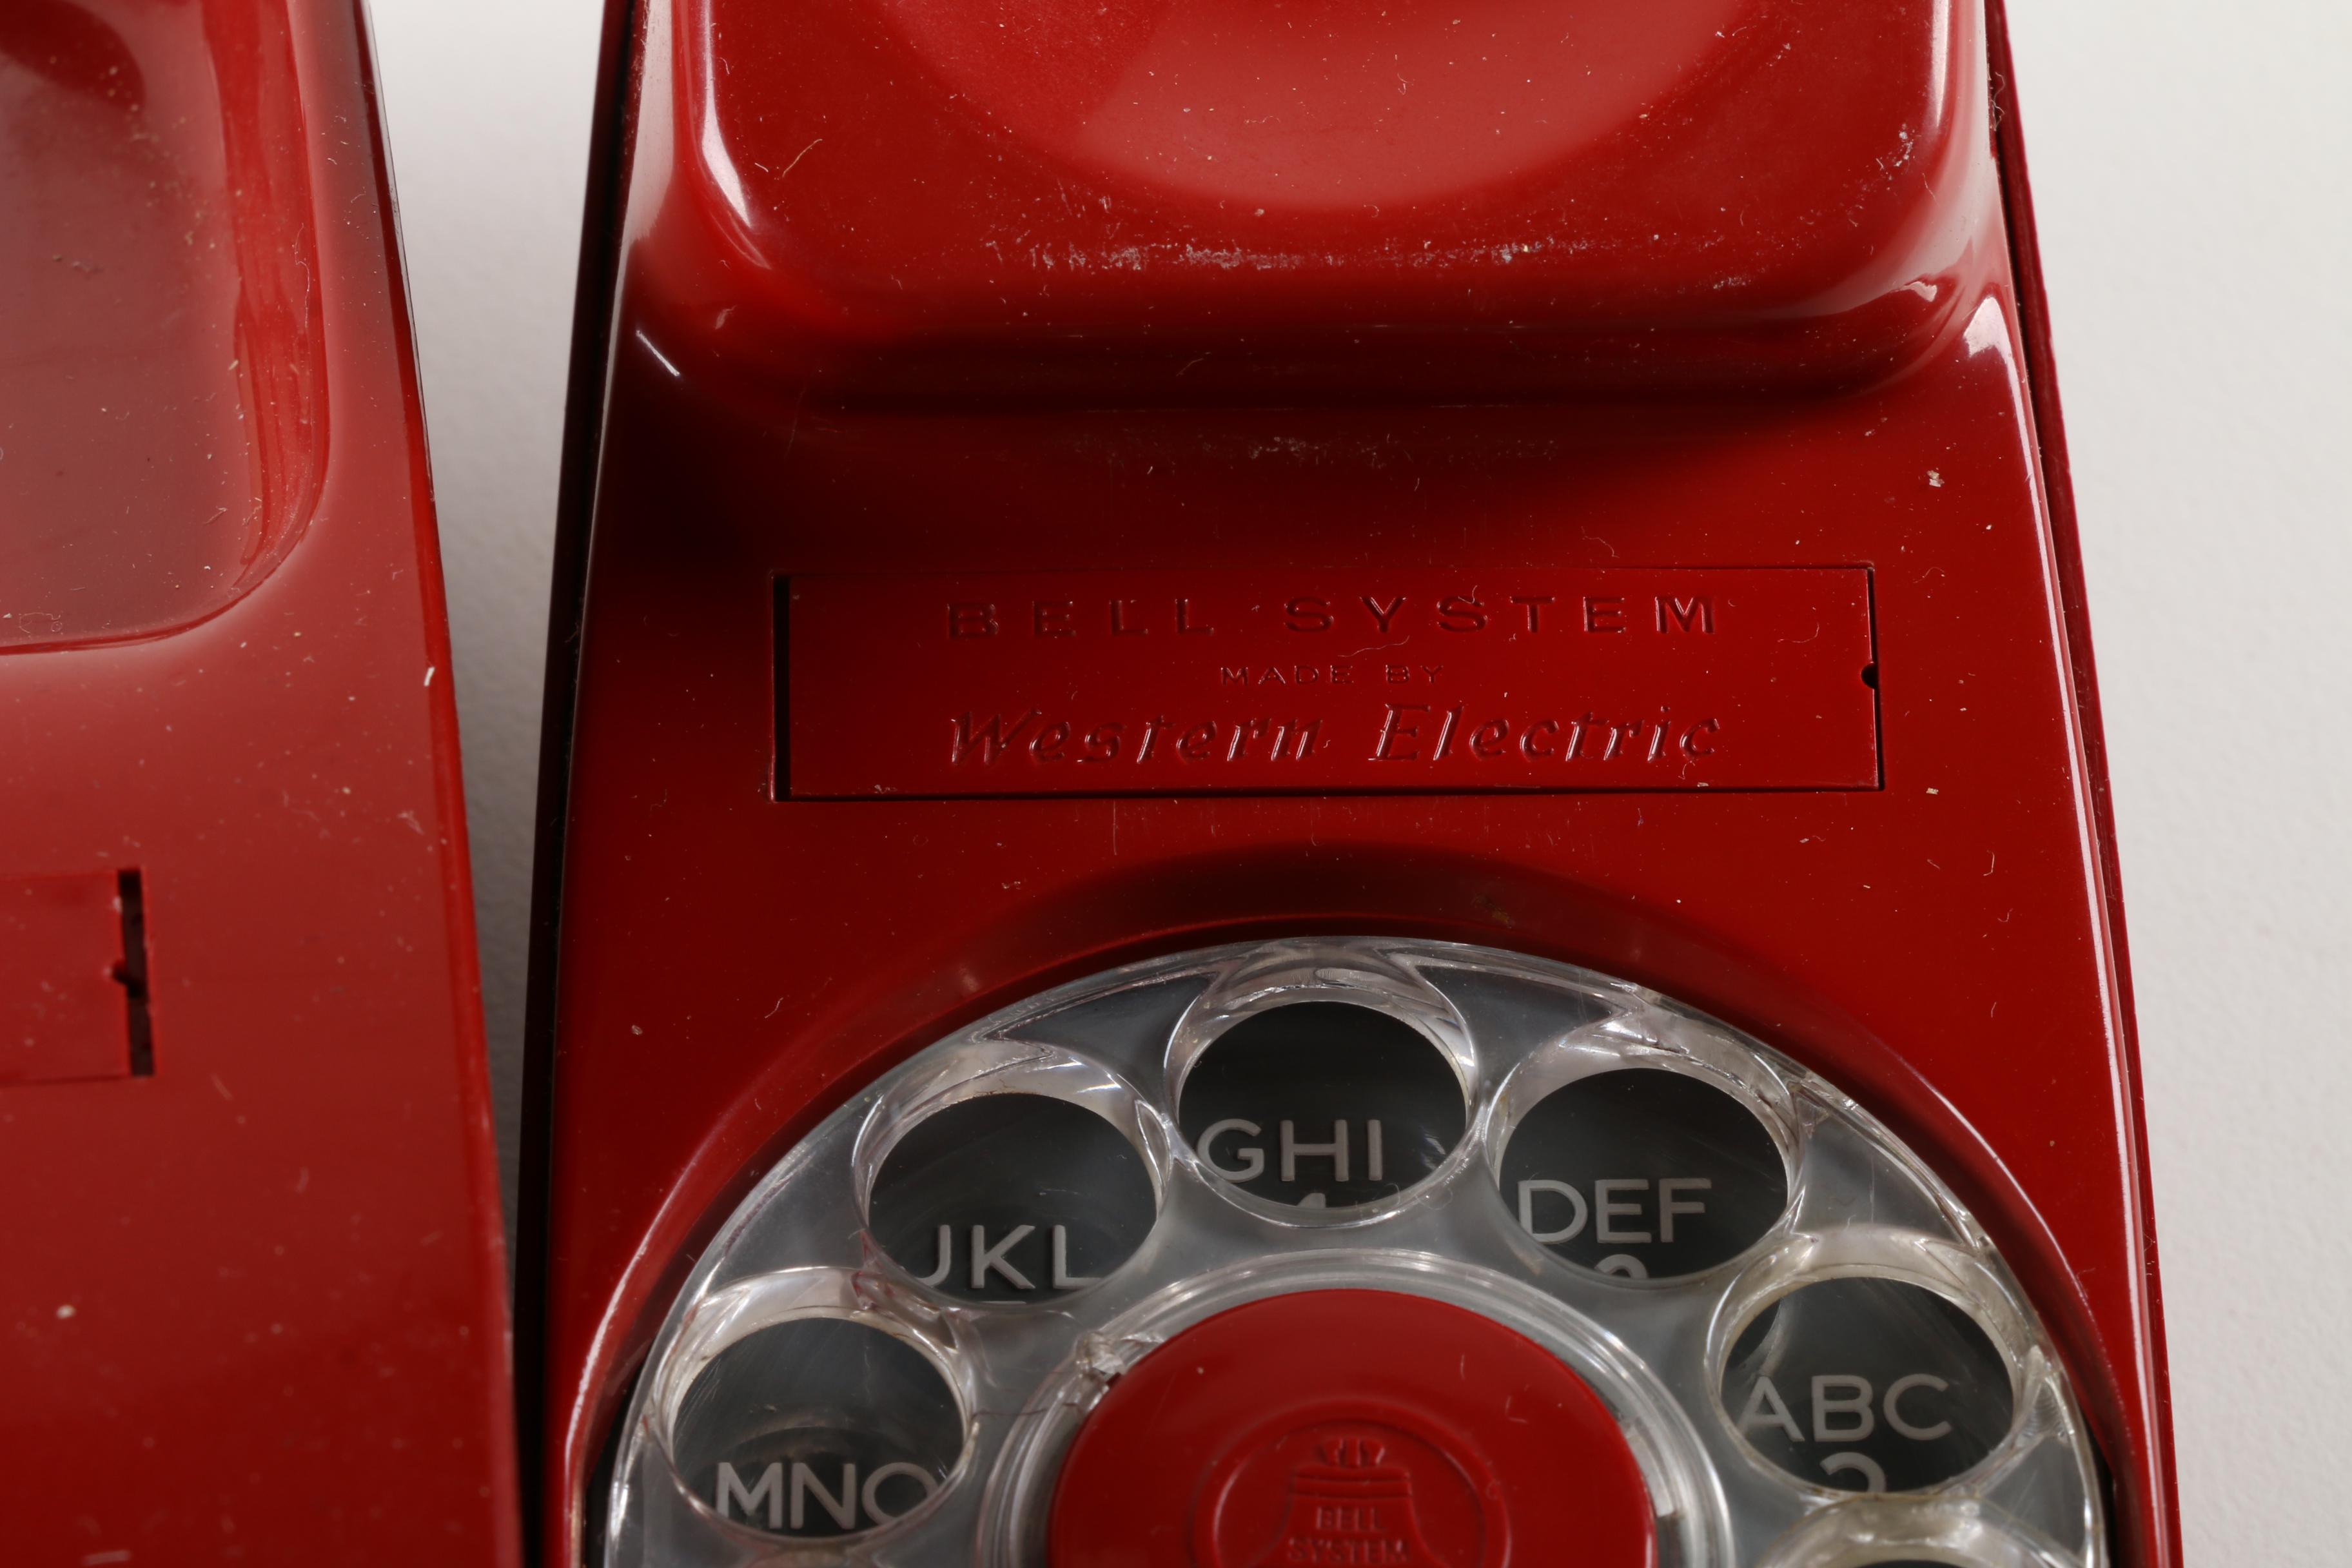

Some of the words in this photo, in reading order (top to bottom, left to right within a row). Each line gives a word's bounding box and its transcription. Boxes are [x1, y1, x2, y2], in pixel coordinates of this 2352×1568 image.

[946, 599, 1215, 637] BELL
[1284, 595, 1716, 634] SYSTEM
[1220, 666, 1355, 685] MADE
[1386, 665, 1444, 685] BY
[950, 710, 1323, 765] Western
[1368, 703, 1720, 761] Electric
[1197, 1118, 1384, 1182] GHI
[1517, 1178, 1712, 1244] DEF
[915, 1224, 1100, 1289] JKL
[1737, 1374, 1952, 1442] ABC
[716, 1462, 937, 1529] MNO
[1316, 1507, 1385, 1531] BELL
[1289, 1538, 1409, 1563] SYSTEM
